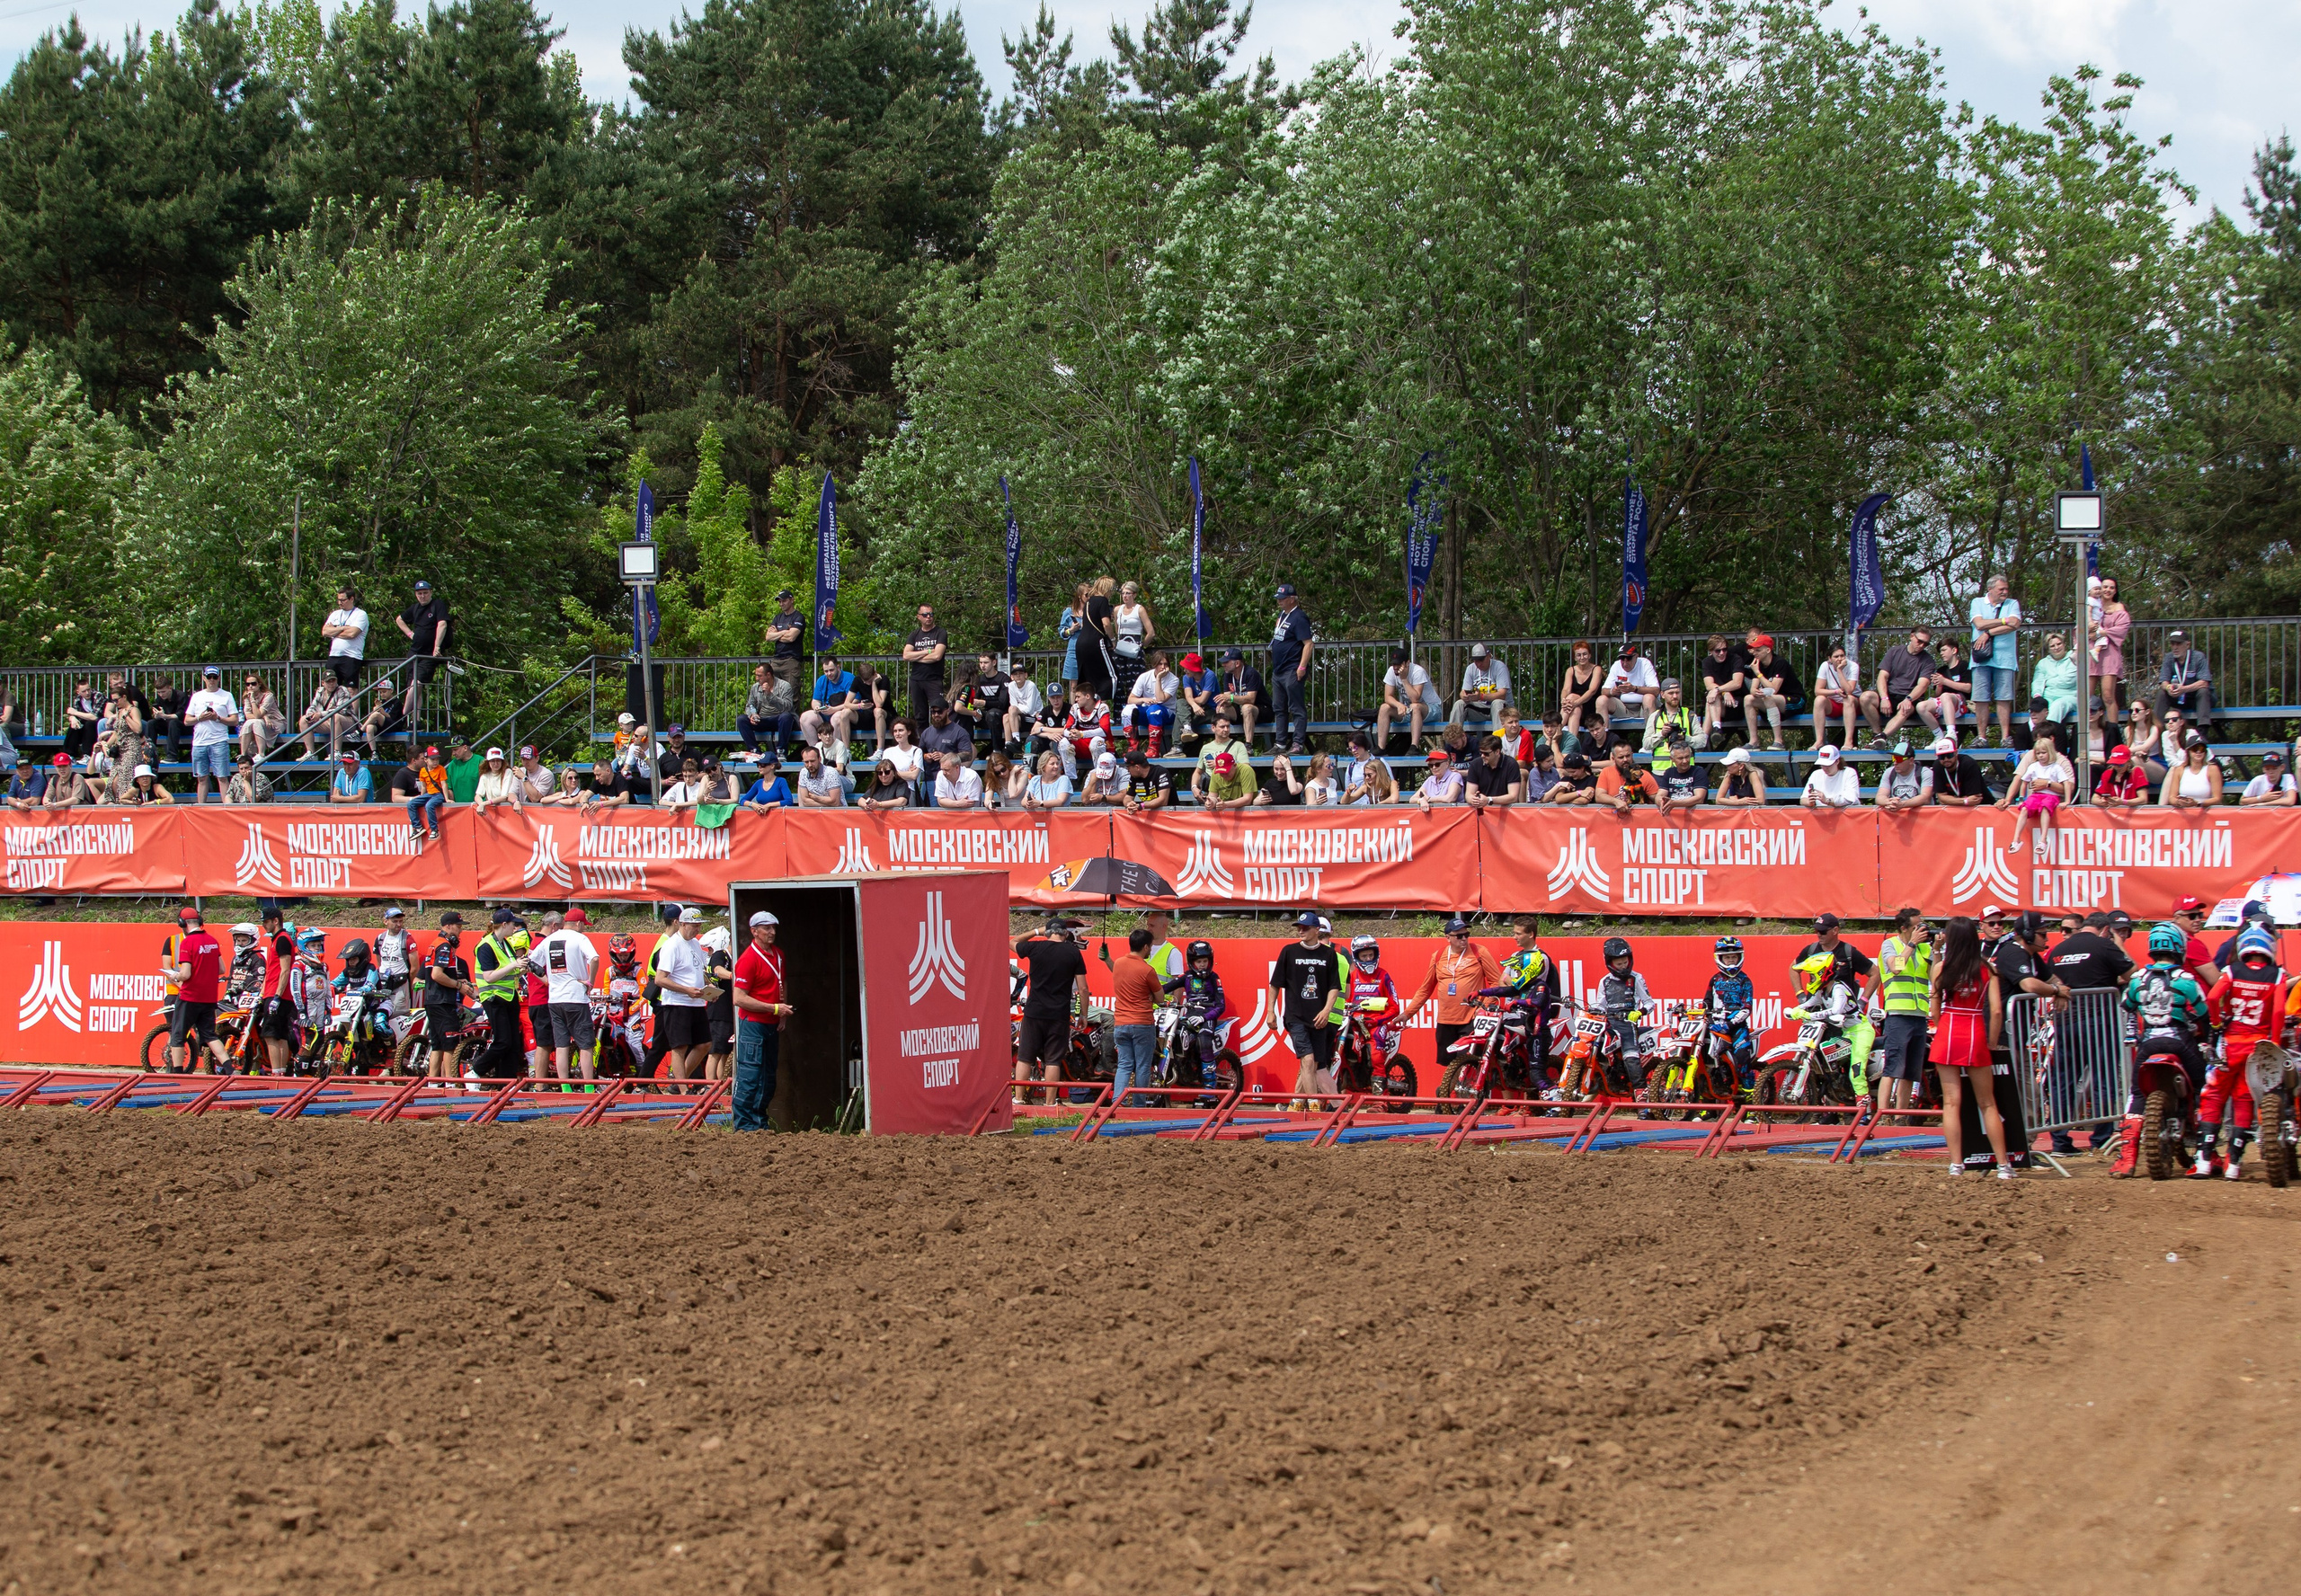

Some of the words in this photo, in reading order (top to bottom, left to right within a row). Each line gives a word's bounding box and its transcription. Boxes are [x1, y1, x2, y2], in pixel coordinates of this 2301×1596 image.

[823, 531, 831, 590] ФЕДЕРАЦИЯ
[915, 639, 937, 647] PROTEST
[5, 818, 134, 856] МОСКОВСКИЙ
[888, 822, 1050, 864] МОСКОВСКИЙ
[1244, 820, 1413, 864] МОСКОВСКИЙ
[1622, 820, 1806, 865] МОСКОВСКИЙ
[2032, 820, 2233, 867] МОСКОВСКИЙ
[7, 858, 67, 889] СПОРТ
[289, 857, 352, 889] СПОРТ
[578, 860, 647, 891] СПОРТ
[1244, 867, 1324, 900] СПОРТ
[1623, 868, 1708, 905] СПОРТ
[2032, 869, 2125, 908] СПОРТ
[90, 974, 167, 1001] МОСКОВС
[239, 997, 255, 1006] 69
[1355, 984, 1380, 993] LEATT
[89, 1006, 138, 1033] СПОРТ
[341, 999, 360, 1011] 212
[901, 1017, 980, 1057] МОСКОВСКИЙ
[1475, 1018, 1497, 1031] 185
[1577, 1019, 1604, 1034] 613
[1681, 1022, 1701, 1033] 117
[1639, 1036, 1656, 1054] 613
[1826, 1046, 1852, 1062] ТАТАРСТА
[923, 1059, 960, 1088] СПОРТ
